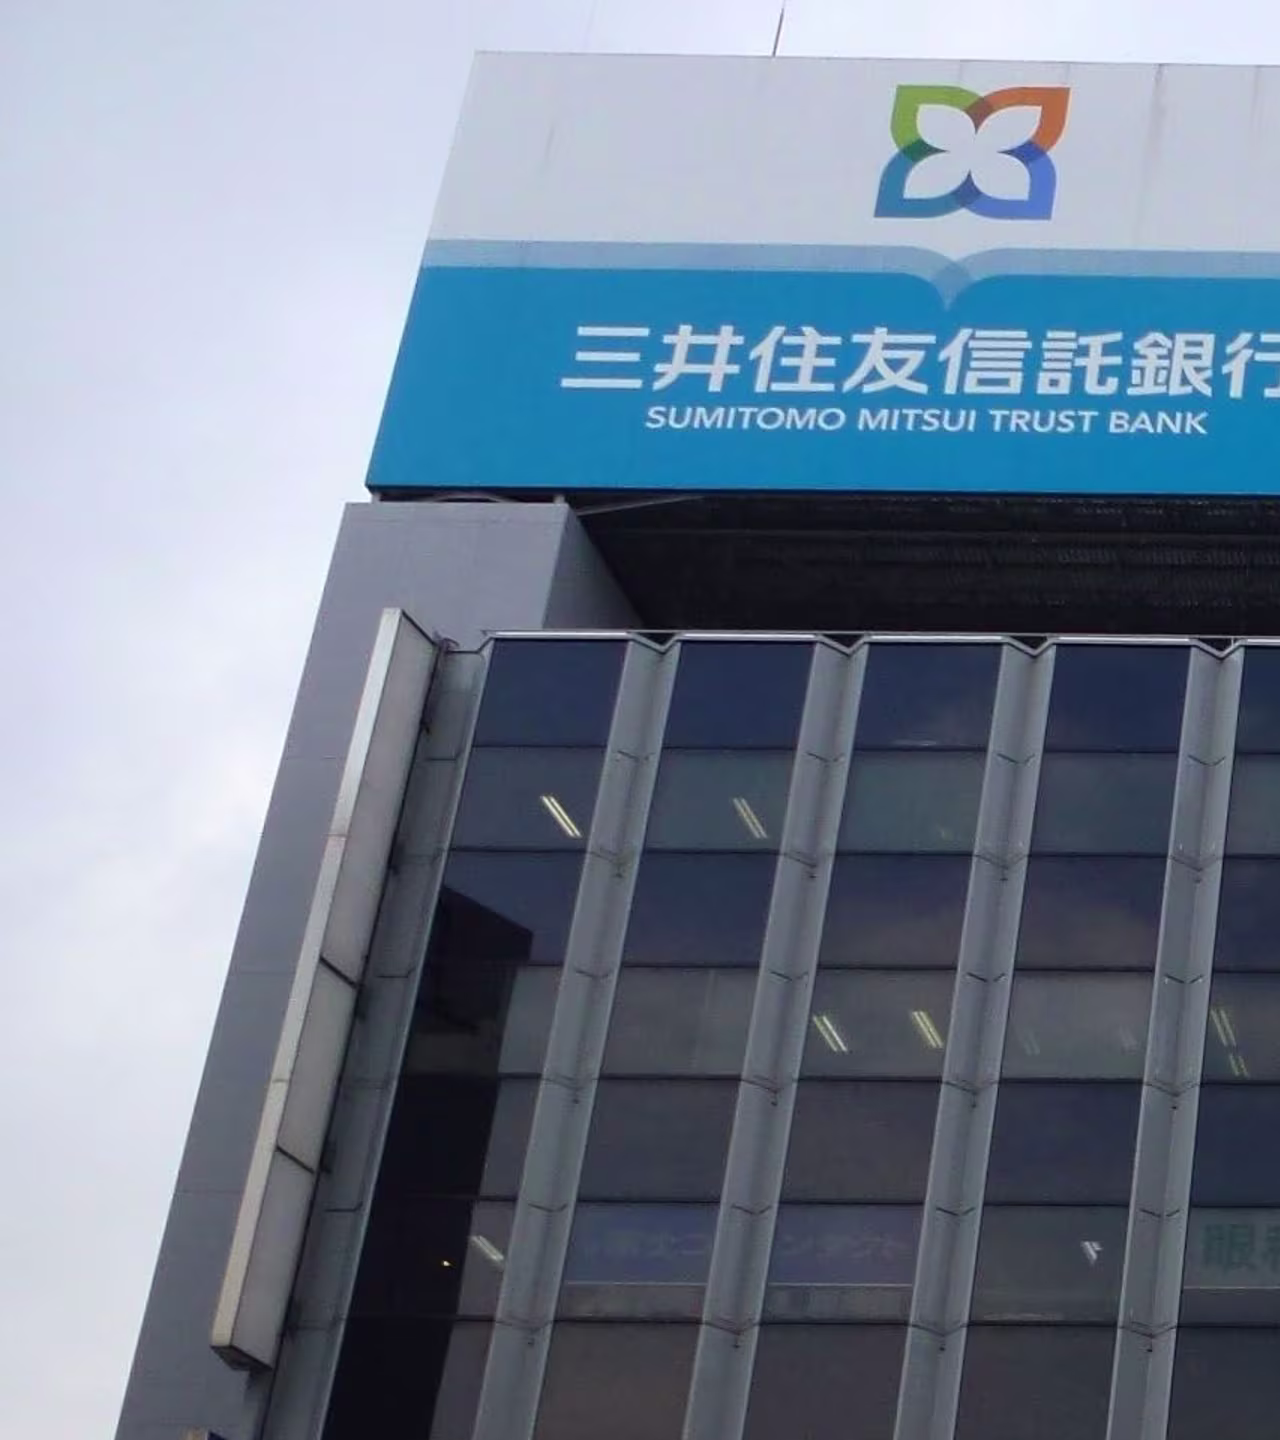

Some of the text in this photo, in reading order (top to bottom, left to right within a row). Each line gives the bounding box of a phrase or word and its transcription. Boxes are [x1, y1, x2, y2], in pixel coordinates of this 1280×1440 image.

[645, 406, 1209, 435] SUMITOMO MITSUI TRUST BANK
